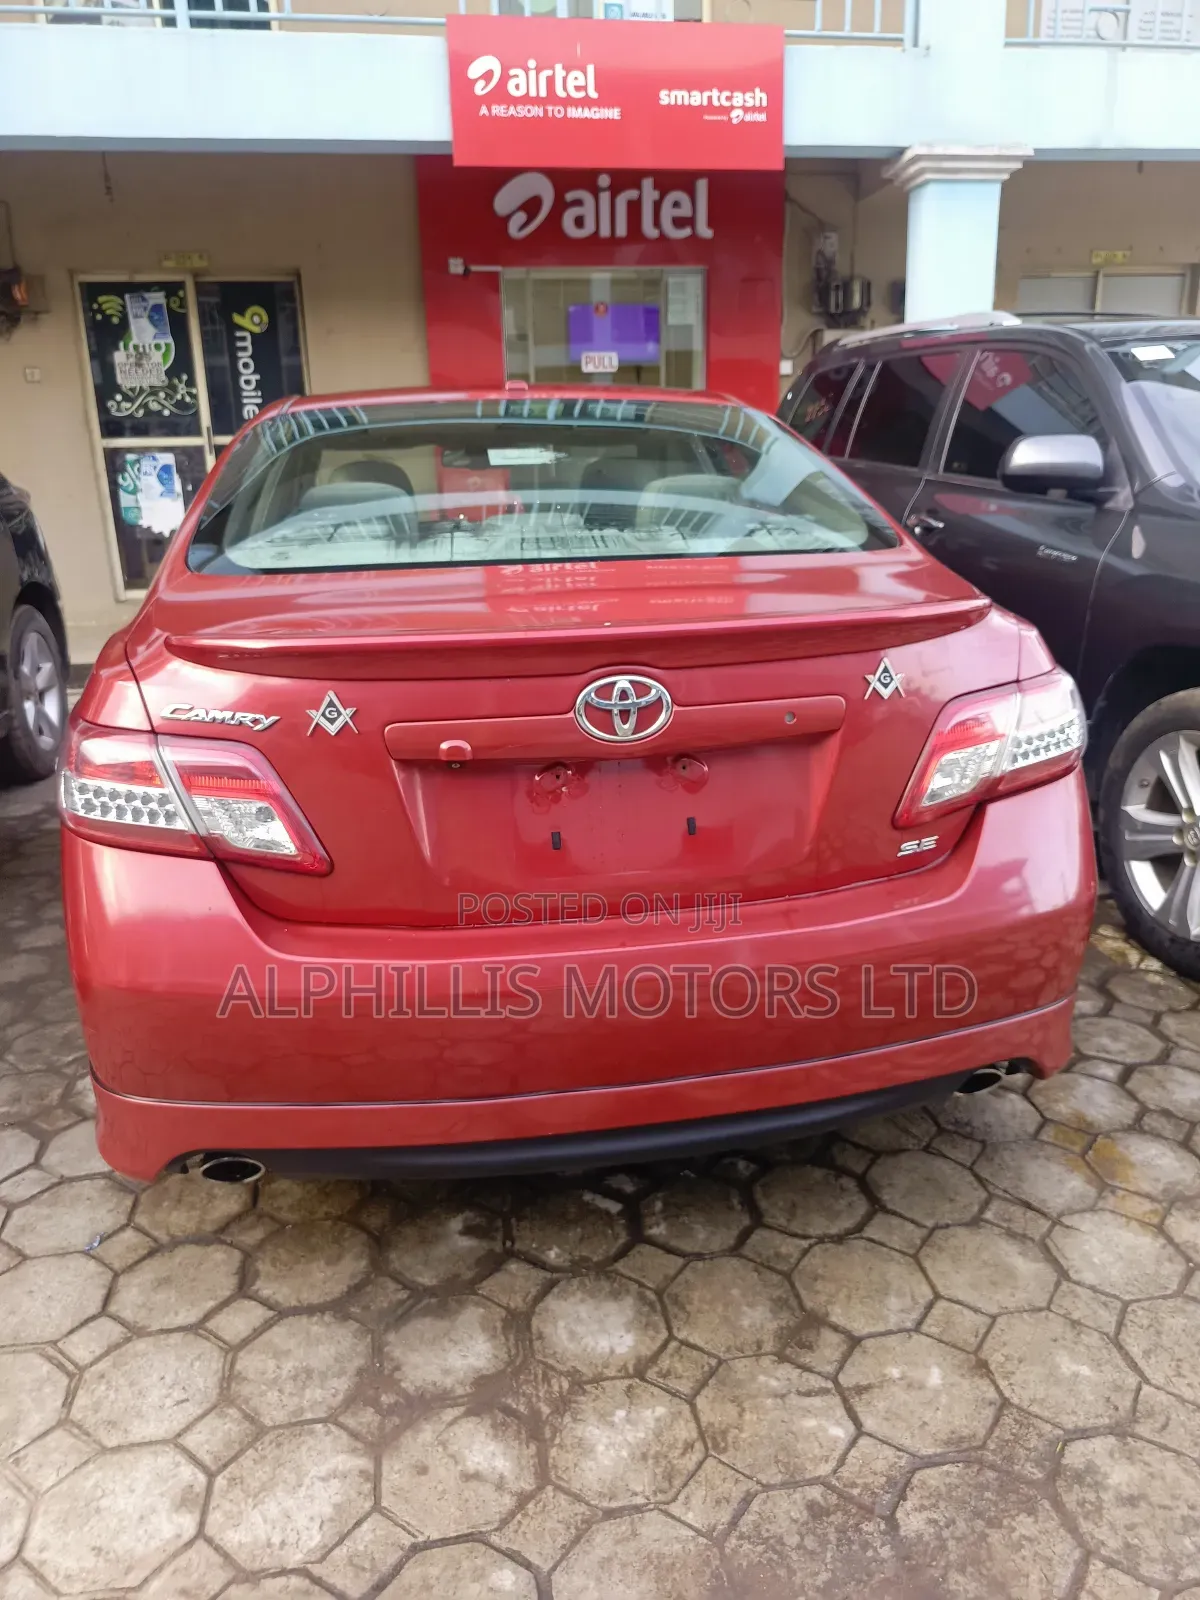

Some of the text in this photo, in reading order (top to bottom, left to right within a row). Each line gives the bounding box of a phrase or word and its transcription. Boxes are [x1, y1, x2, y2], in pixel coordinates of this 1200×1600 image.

[506, 58, 599, 99] airtel
[659, 87, 768, 108] smartcash
[479, 104, 621, 120] A REASON TO IMAGINE
[562, 173, 714, 240] airtel
[584, 355, 616, 369] PULL
[880, 672, 891, 684] G
[160, 703, 281, 731] CAMRY
[325, 707, 338, 719] G
[896, 835, 940, 858] SE
